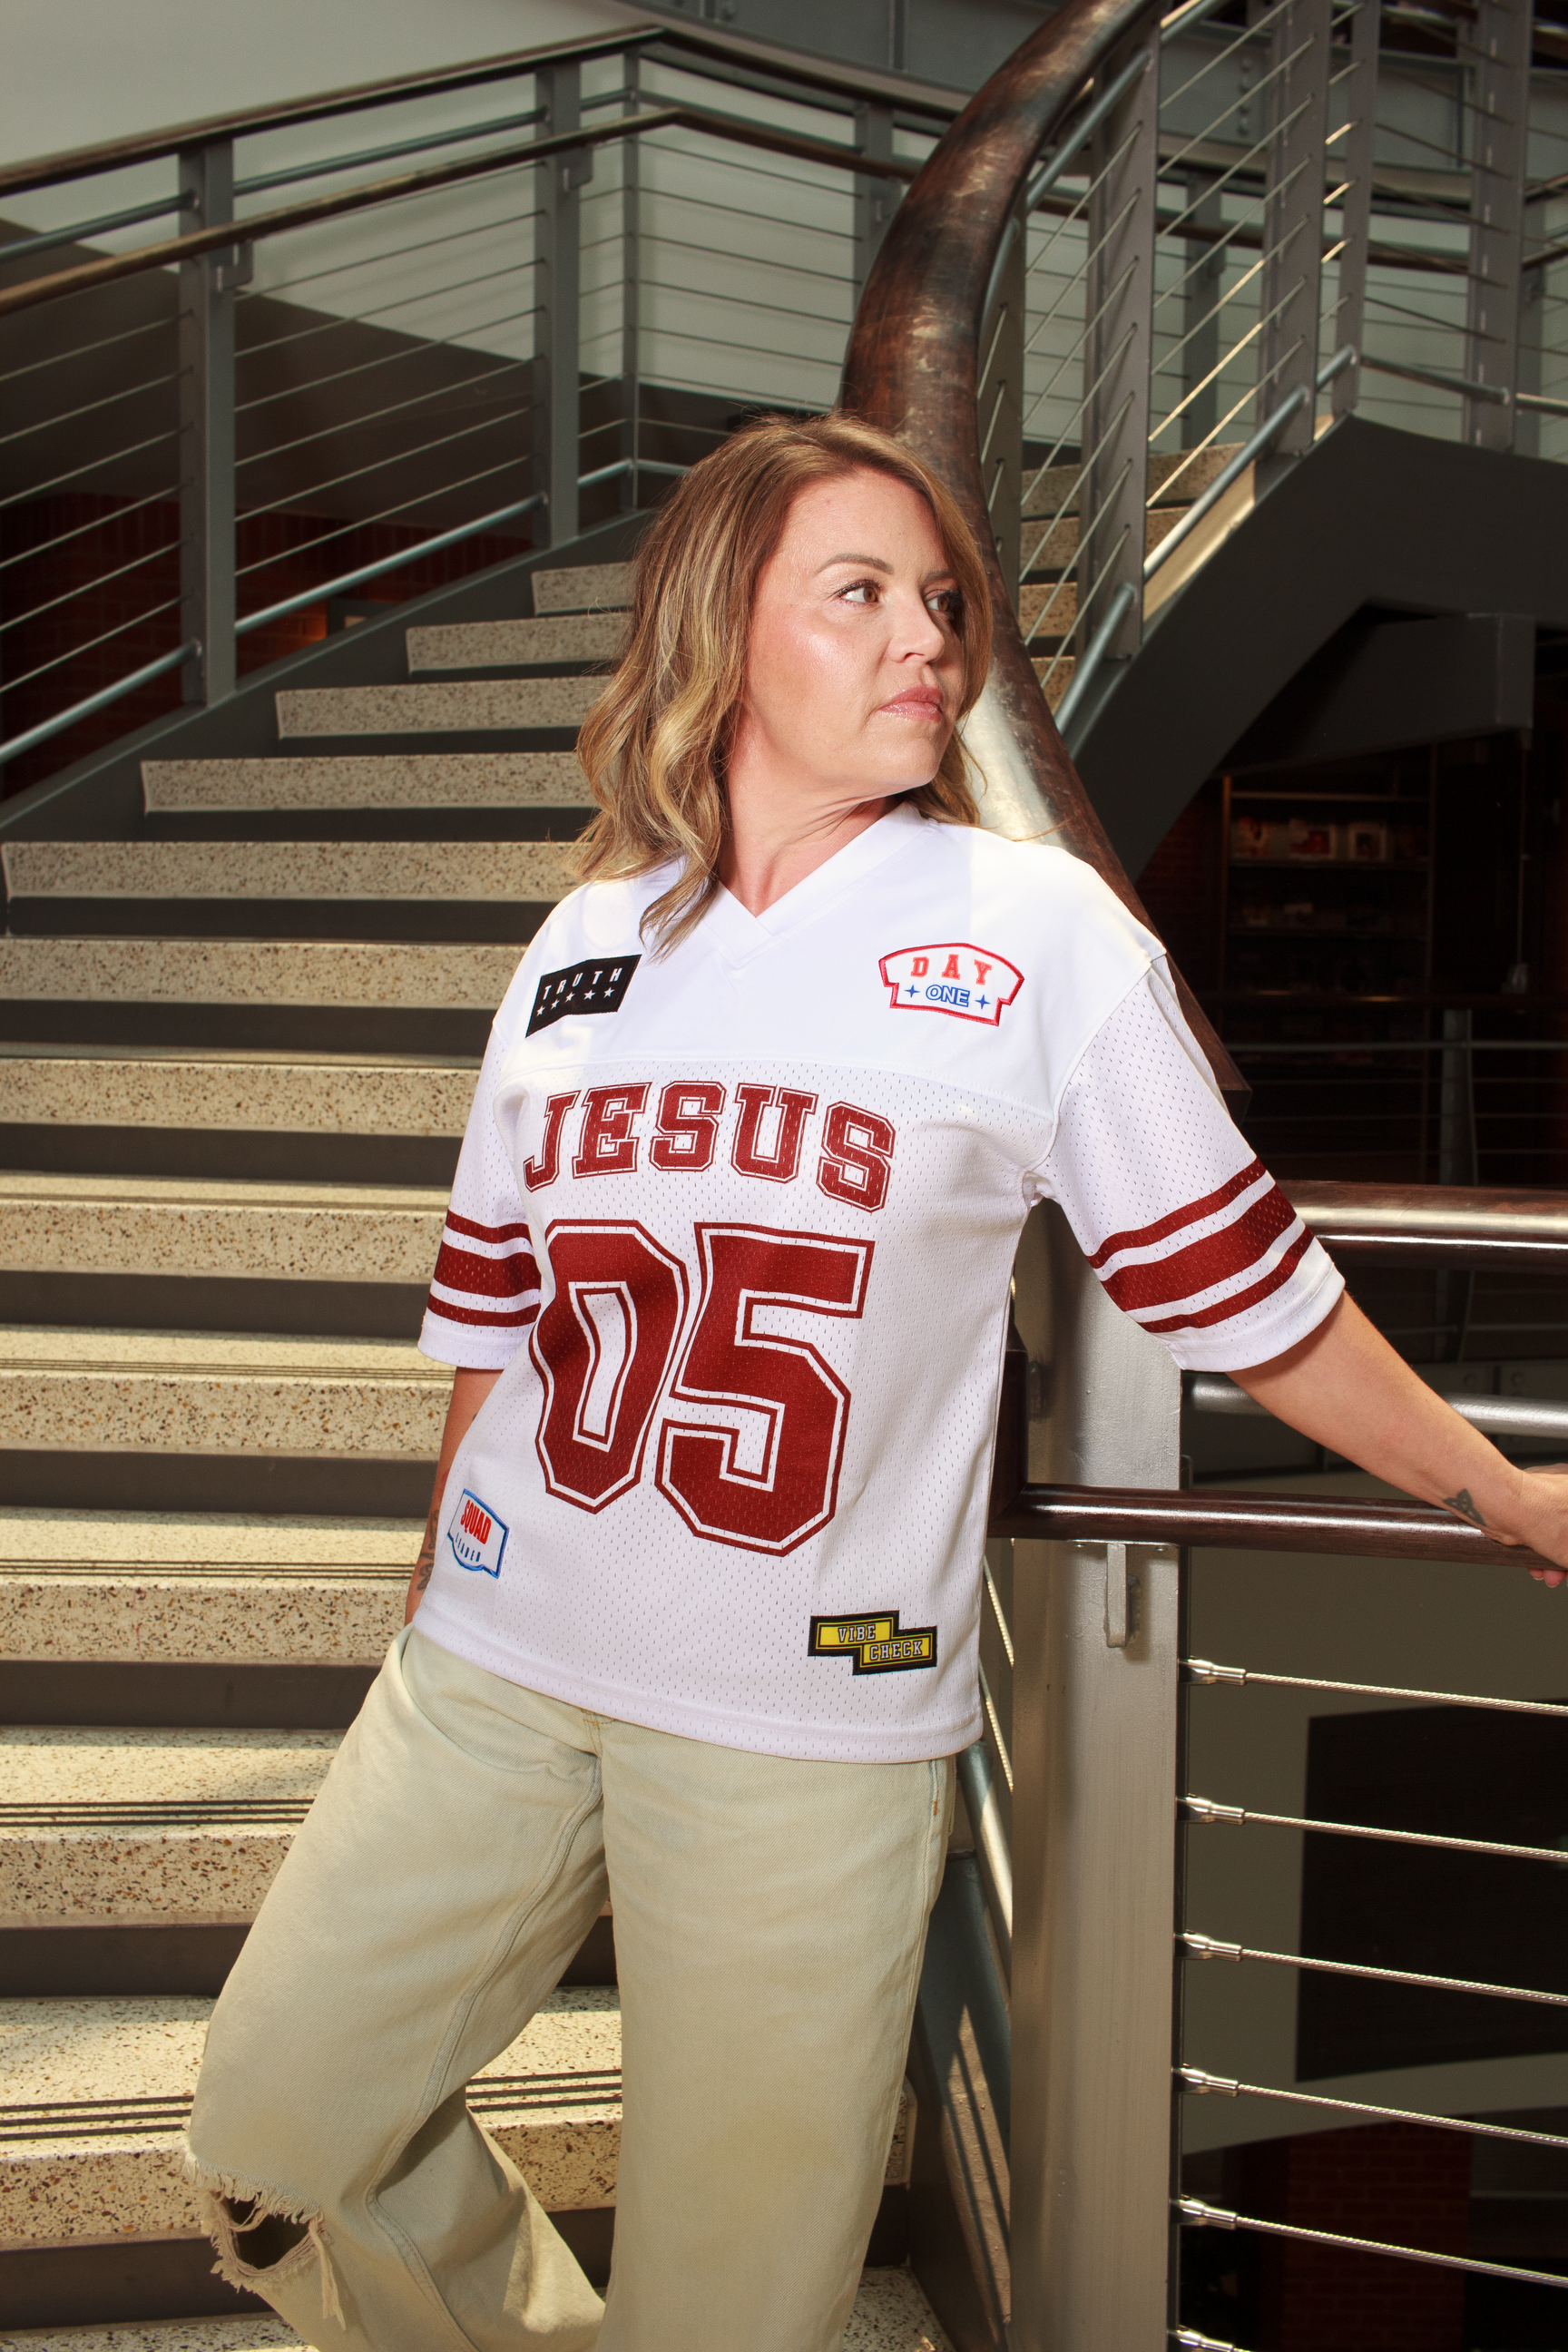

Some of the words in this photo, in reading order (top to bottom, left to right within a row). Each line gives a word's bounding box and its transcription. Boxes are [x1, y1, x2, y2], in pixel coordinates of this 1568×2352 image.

[544, 967, 622, 1000] TRUTH
[910, 954, 993, 985] DAY
[926, 984, 970, 1007] ONE
[523, 1080, 897, 1213] JESUS
[528, 1219, 876, 1558] 05
[460, 1499, 492, 1544] SQUAD
[838, 1624, 876, 1642] VIBE
[869, 1640, 923, 1661] CHECK
